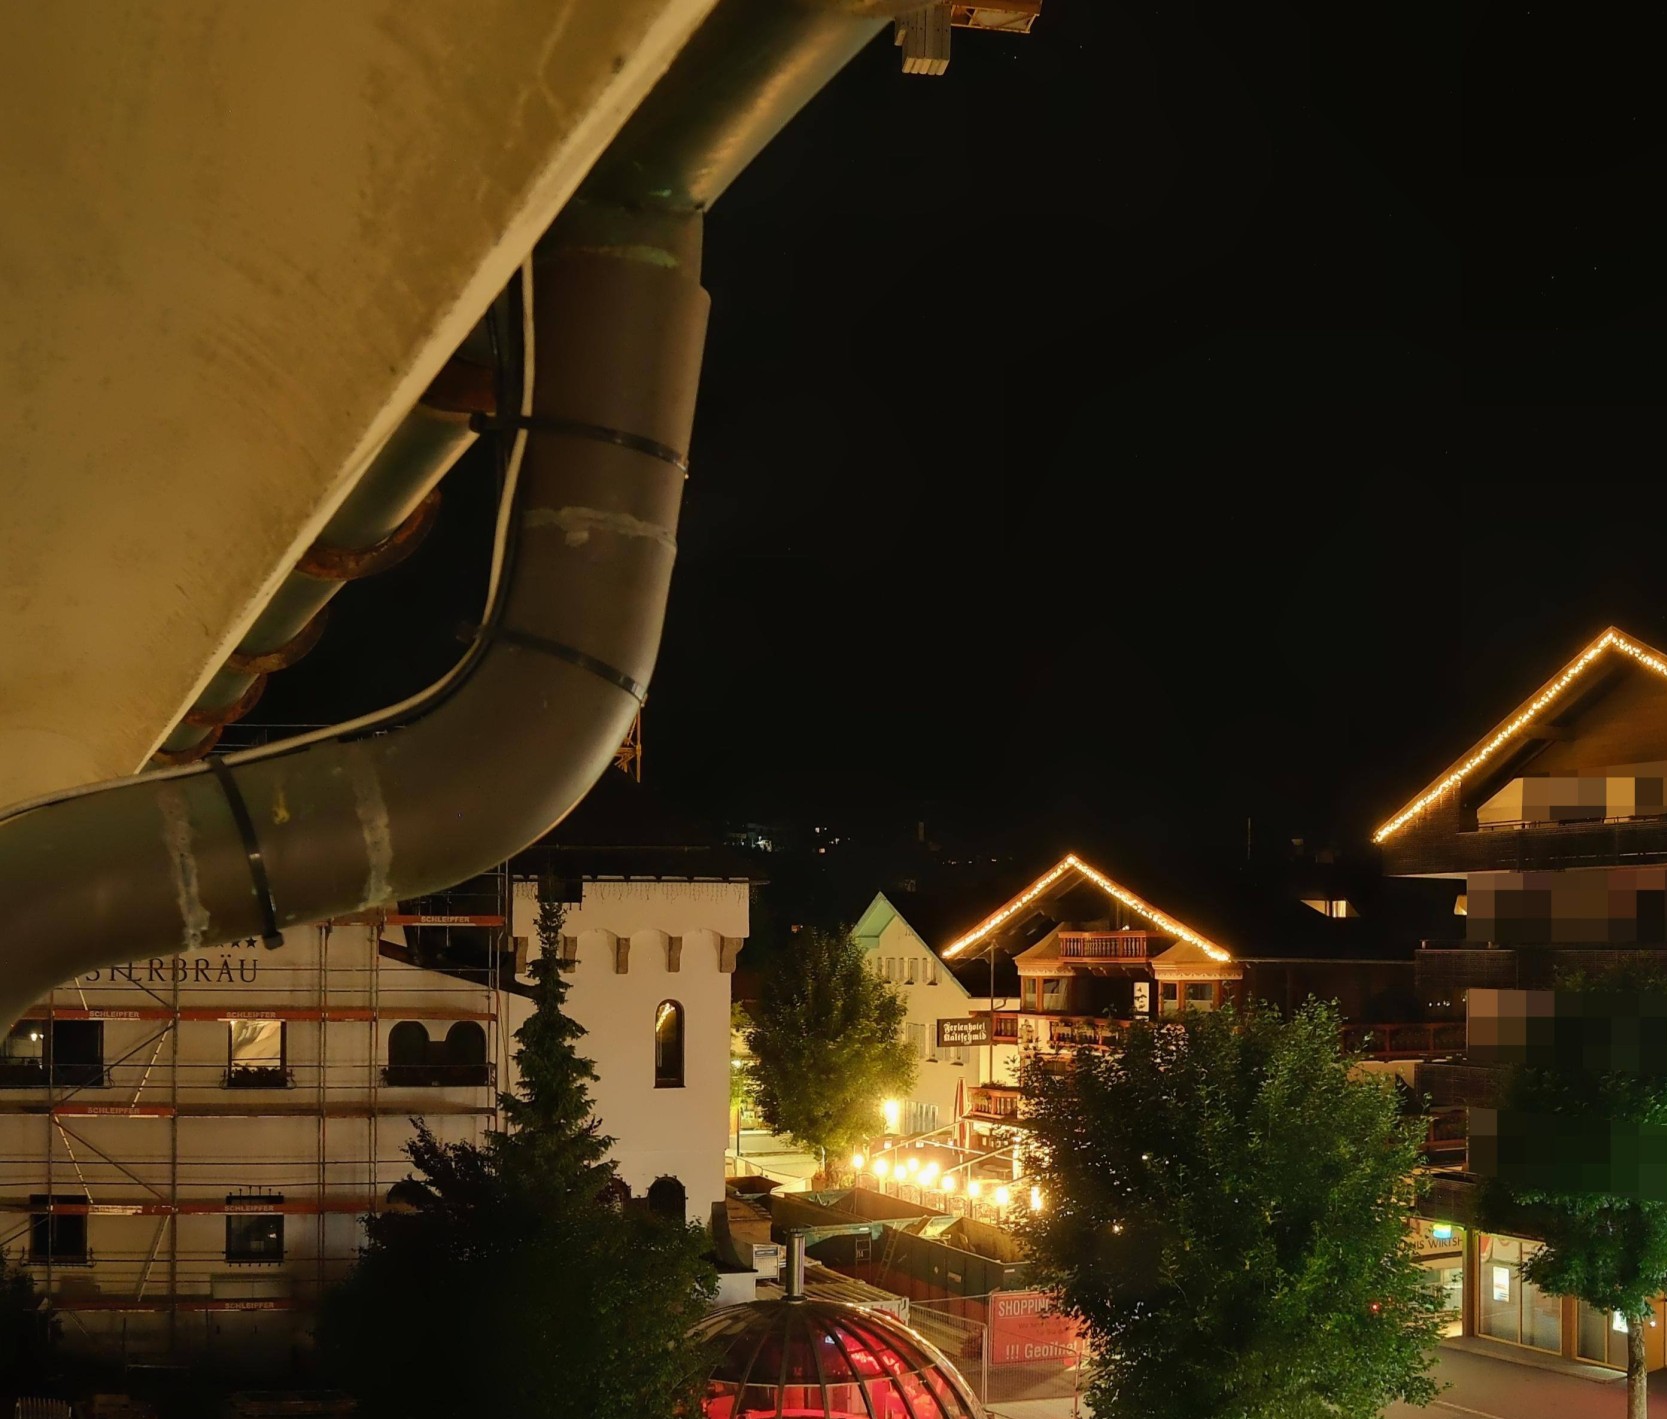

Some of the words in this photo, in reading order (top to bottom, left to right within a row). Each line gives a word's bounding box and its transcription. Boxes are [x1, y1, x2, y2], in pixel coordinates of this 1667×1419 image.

[89, 1010, 140, 1018] SCHLEIPFER
[226, 1010, 276, 1018] SCHLEIPFER
[943, 1022, 986, 1033] Ferienhotel
[943, 1030, 987, 1045] Kaltschmid
[998, 1298, 1051, 1317] SHOPPIN
